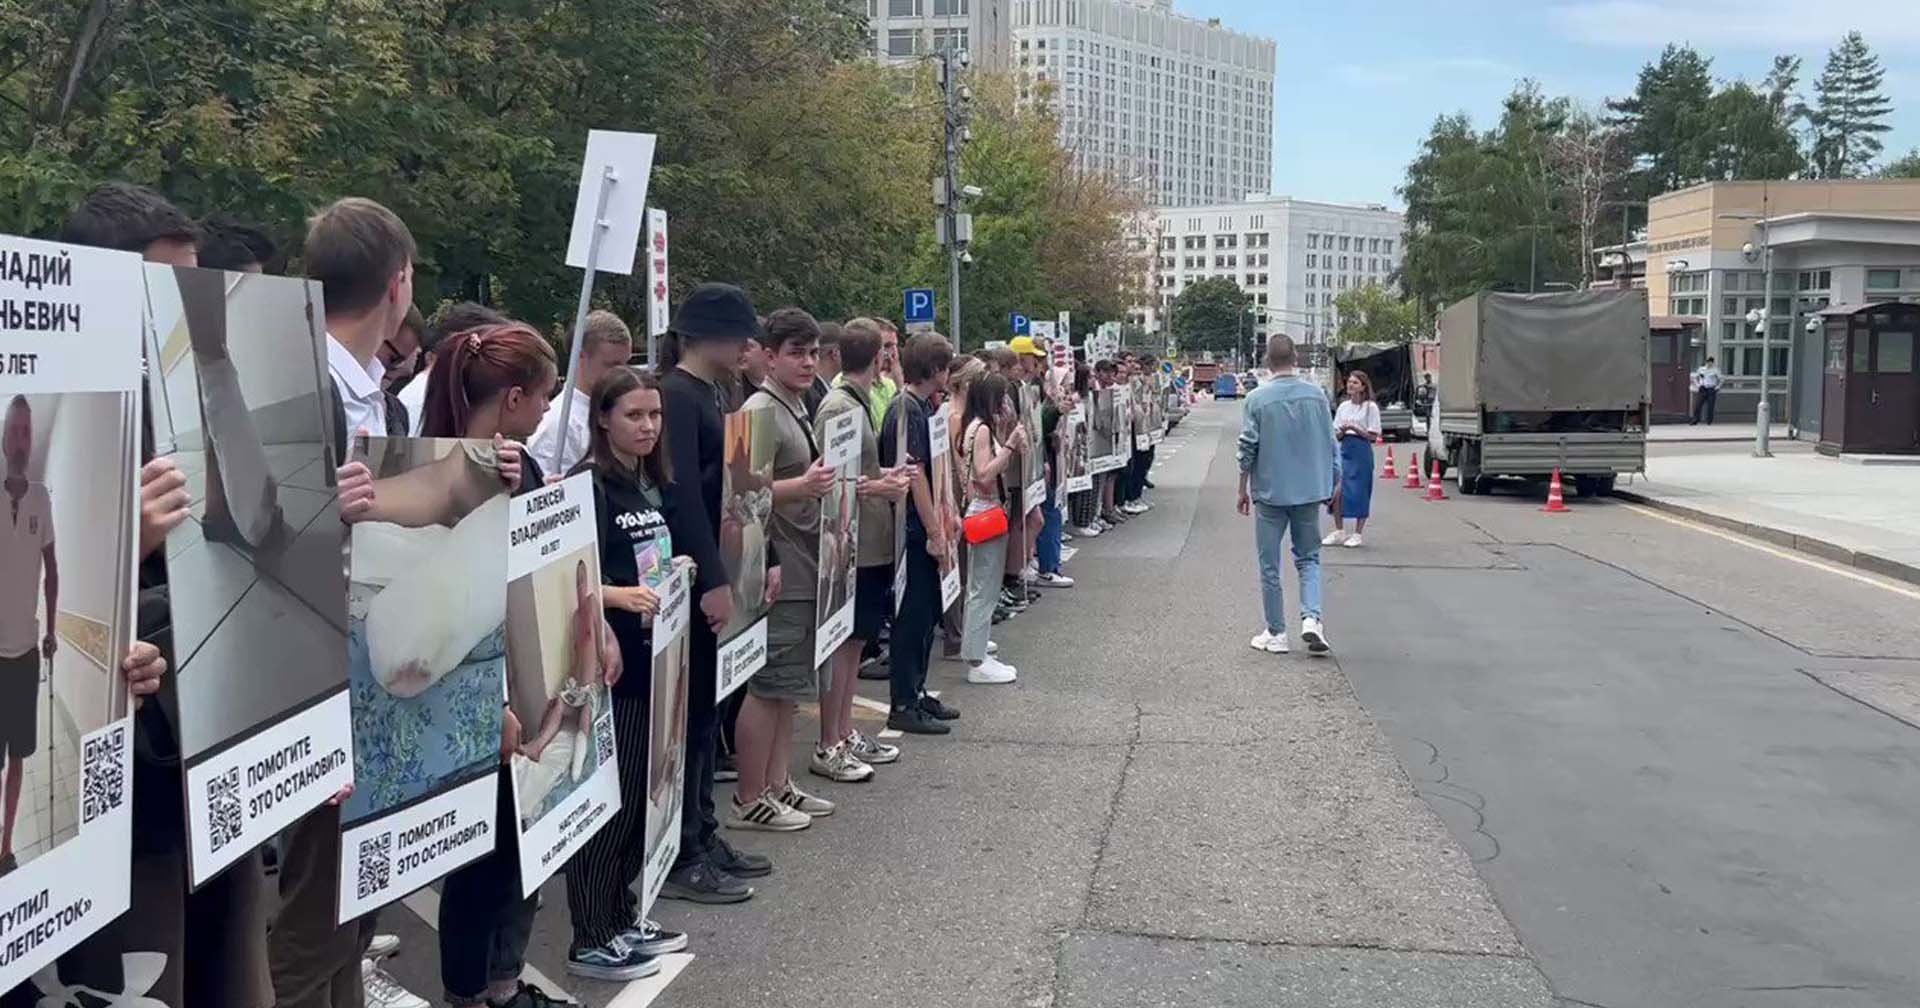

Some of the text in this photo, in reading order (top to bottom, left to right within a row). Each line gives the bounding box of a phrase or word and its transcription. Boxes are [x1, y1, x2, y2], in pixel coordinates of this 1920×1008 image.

[0, 299, 80, 333] НЬЕВИЧ
[912, 292, 929, 317] P
[8, 353, 38, 375] ЛЕТ
[526, 483, 566, 516] АЛЕКСЕЙ
[510, 503, 581, 546] ВЛАДИМИРОВИЧ
[246, 735, 312, 788] ПОМОГИТЕ
[249, 747, 347, 819] ЭТО ОСТАНОВИТЬ
[397, 820, 490, 876] ЭТО ОСТАНОВИТЬ
[398, 809, 457, 851] ПОМОГИТЕ
